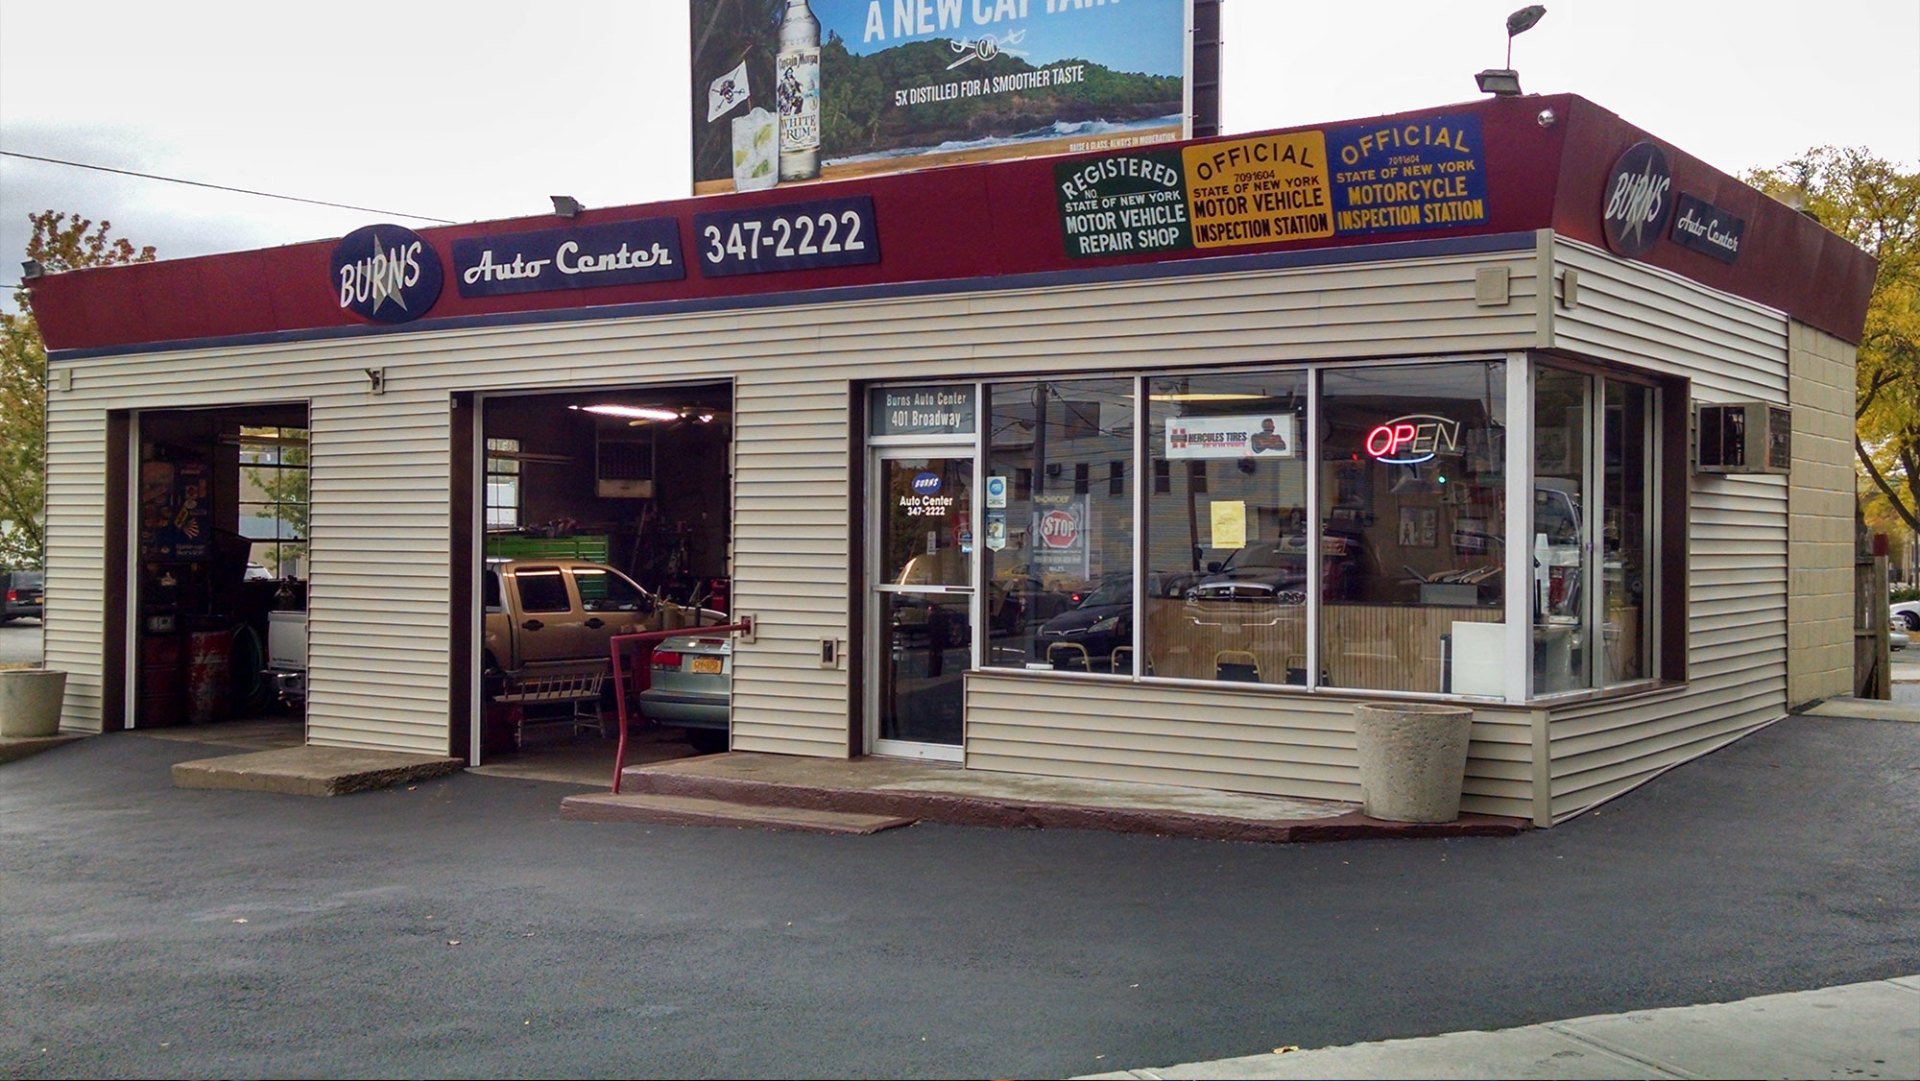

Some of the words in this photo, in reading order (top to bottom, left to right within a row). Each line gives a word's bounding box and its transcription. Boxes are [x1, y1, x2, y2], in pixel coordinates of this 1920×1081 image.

[863, 0, 885, 43] A
[893, 0, 963, 38] NEW
[895, 89, 908, 106] 5X
[910, 83, 958, 104] DISTILLED
[961, 80, 980, 97] FOR
[983, 78, 990, 94] A
[992, 70, 1050, 93] SMOOTHER
[1052, 65, 1084, 85] TASTE
[780, 114, 816, 129] WHITE
[786, 127, 811, 140] RUM
[1342, 125, 1470, 165] OFFICIAL
[1197, 143, 1314, 180] OFFICIAL
[1234, 170, 1275, 182] 7091604
[1336, 170, 1376, 183] STATE
[1381, 168, 1398, 179] OF
[1403, 164, 1432, 176] NEW
[1438, 160, 1475, 173] YORK
[1062, 158, 1178, 200] REGISTERED
[1193, 186, 1229, 198] STATE
[1234, 183, 1249, 194] OF
[1254, 180, 1280, 192] NEW
[1286, 176, 1320, 188] YORK
[1348, 176, 1468, 206] MOTORCYCLE
[1065, 200, 1098, 212] STATE
[1102, 198, 1116, 208] OF
[1120, 194, 1145, 206] NEW
[1149, 190, 1181, 203] YORK
[1194, 196, 1248, 218] MOTOR
[1253, 188, 1324, 212] VEHICLE
[1605, 172, 1670, 222] BURNS
[1066, 212, 1117, 234] MOTOR
[1119, 204, 1186, 228] VEHICLE
[1196, 219, 1270, 243] INSPECTION
[1275, 213, 1328, 236] STATION
[1338, 205, 1420, 230] INSPECTION
[1424, 198, 1484, 223] STATION
[704, 210, 864, 264] 347-2222
[1079, 232, 1134, 254] REPAIR
[1138, 227, 1179, 248] SHOP
[1678, 208, 1707, 236] Auto
[1707, 219, 1738, 252] Center
[340, 241, 422, 308] BURNS
[464, 250, 550, 284] Auto
[556, 241, 672, 274] Center
[886, 394, 910, 406] Burns
[914, 393, 934, 406] Auto
[938, 392, 966, 405] Center
[892, 410, 908, 426] 401
[912, 410, 961, 428] Broadway
[1188, 433, 1224, 442] HERCULES
[1226, 432, 1248, 442] TIRES
[1367, 422, 1460, 456] OPEN
[915, 478, 939, 488] BURNS
[900, 496, 920, 506] Auto
[922, 495, 953, 506] Center
[908, 506, 946, 516] 347-2222
[1044, 516, 1074, 538] STOP
